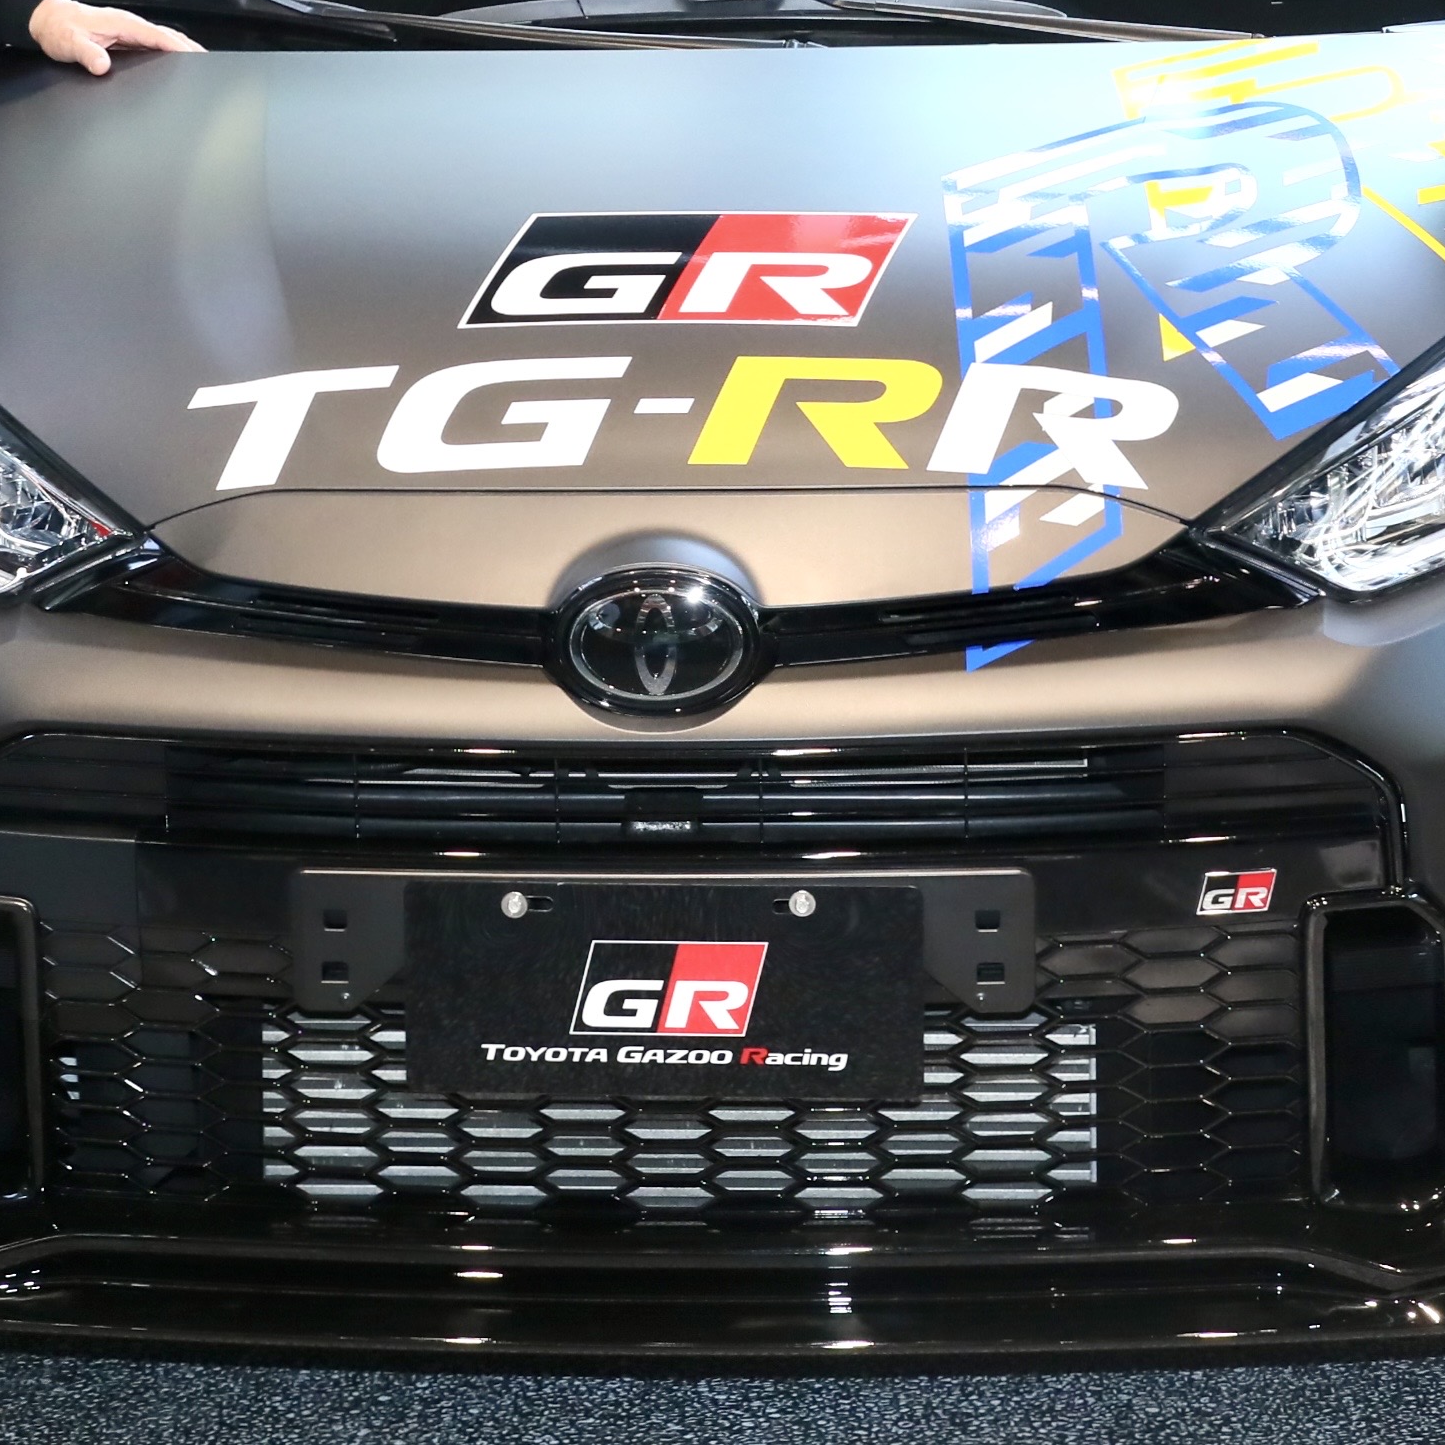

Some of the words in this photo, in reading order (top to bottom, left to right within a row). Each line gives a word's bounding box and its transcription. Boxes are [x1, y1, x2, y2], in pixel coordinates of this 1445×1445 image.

[490, 252, 873, 316] GR
[1202, 887, 1268, 910] GR
[581, 979, 749, 1031] GR
[481, 1043, 609, 1065] TOYOTA
[615, 1044, 733, 1066] GAZOO
[739, 1046, 849, 1071] Racing
